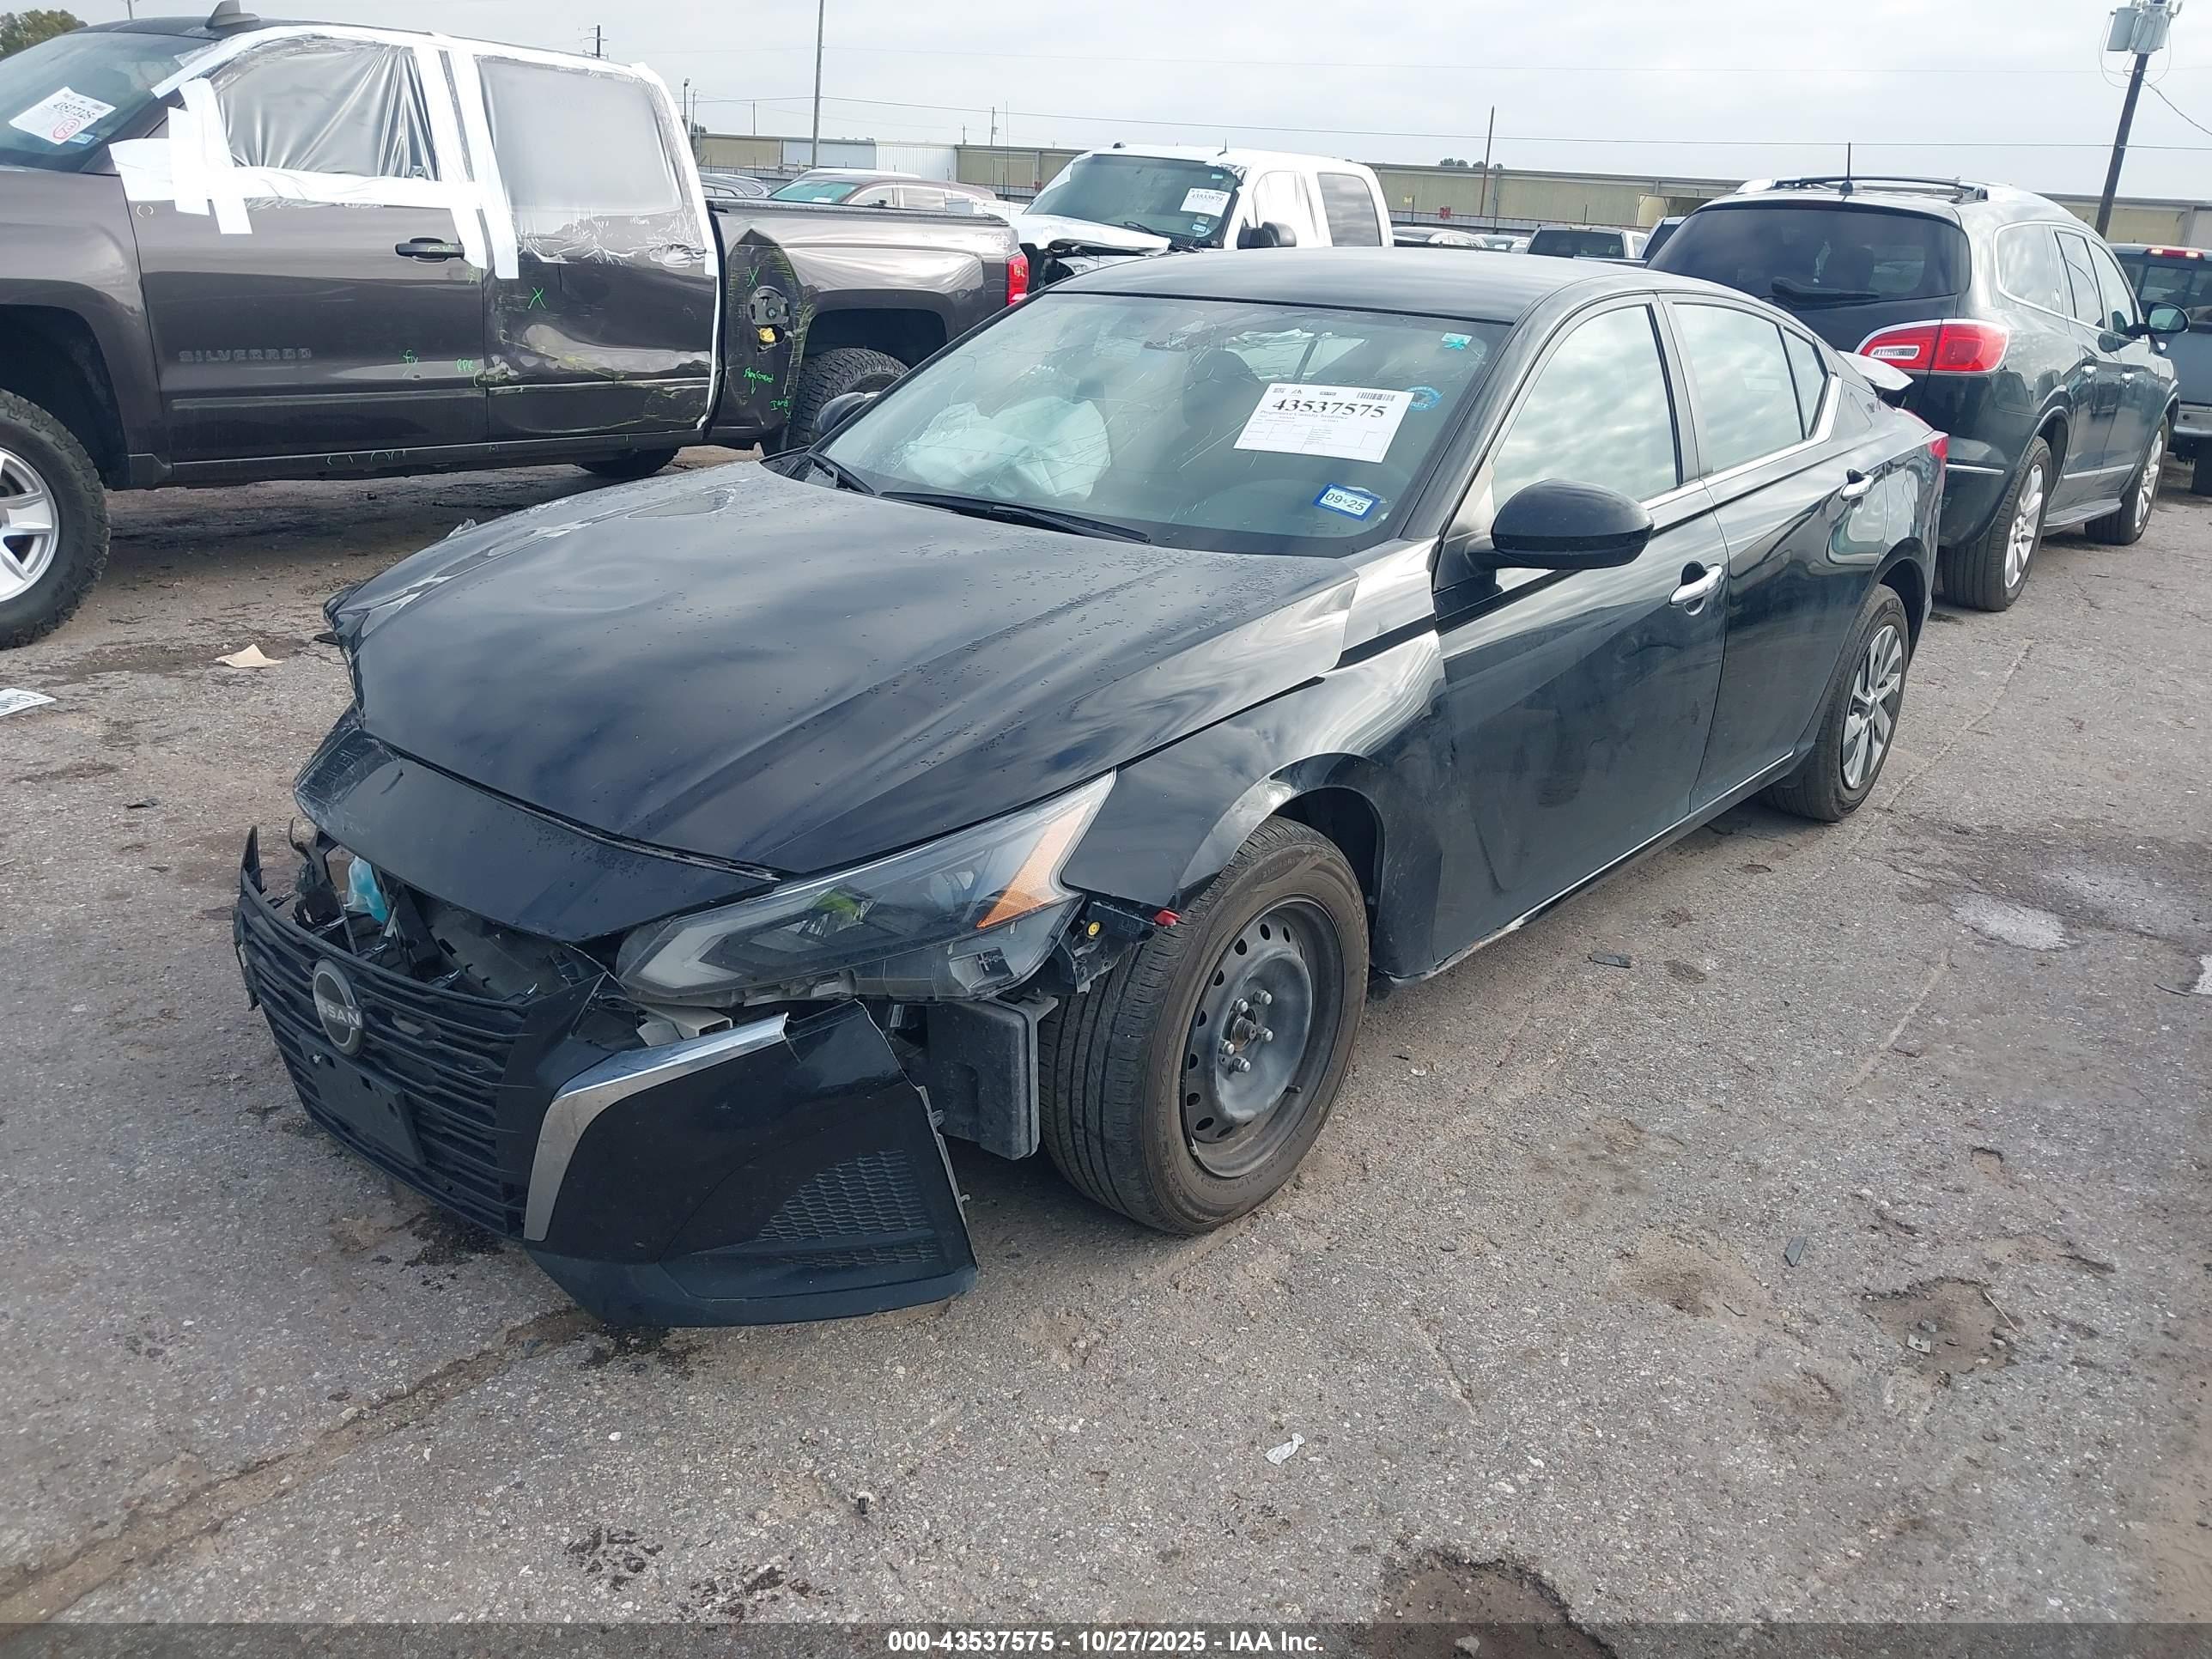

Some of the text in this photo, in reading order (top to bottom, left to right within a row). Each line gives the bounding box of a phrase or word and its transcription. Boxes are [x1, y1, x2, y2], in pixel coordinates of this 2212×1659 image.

[178, 347, 312, 363] SILVERADO
[1272, 398, 1388, 419] 43537575
[1325, 492, 1367, 512] 09 25
[318, 1000, 361, 1026] SSAN
